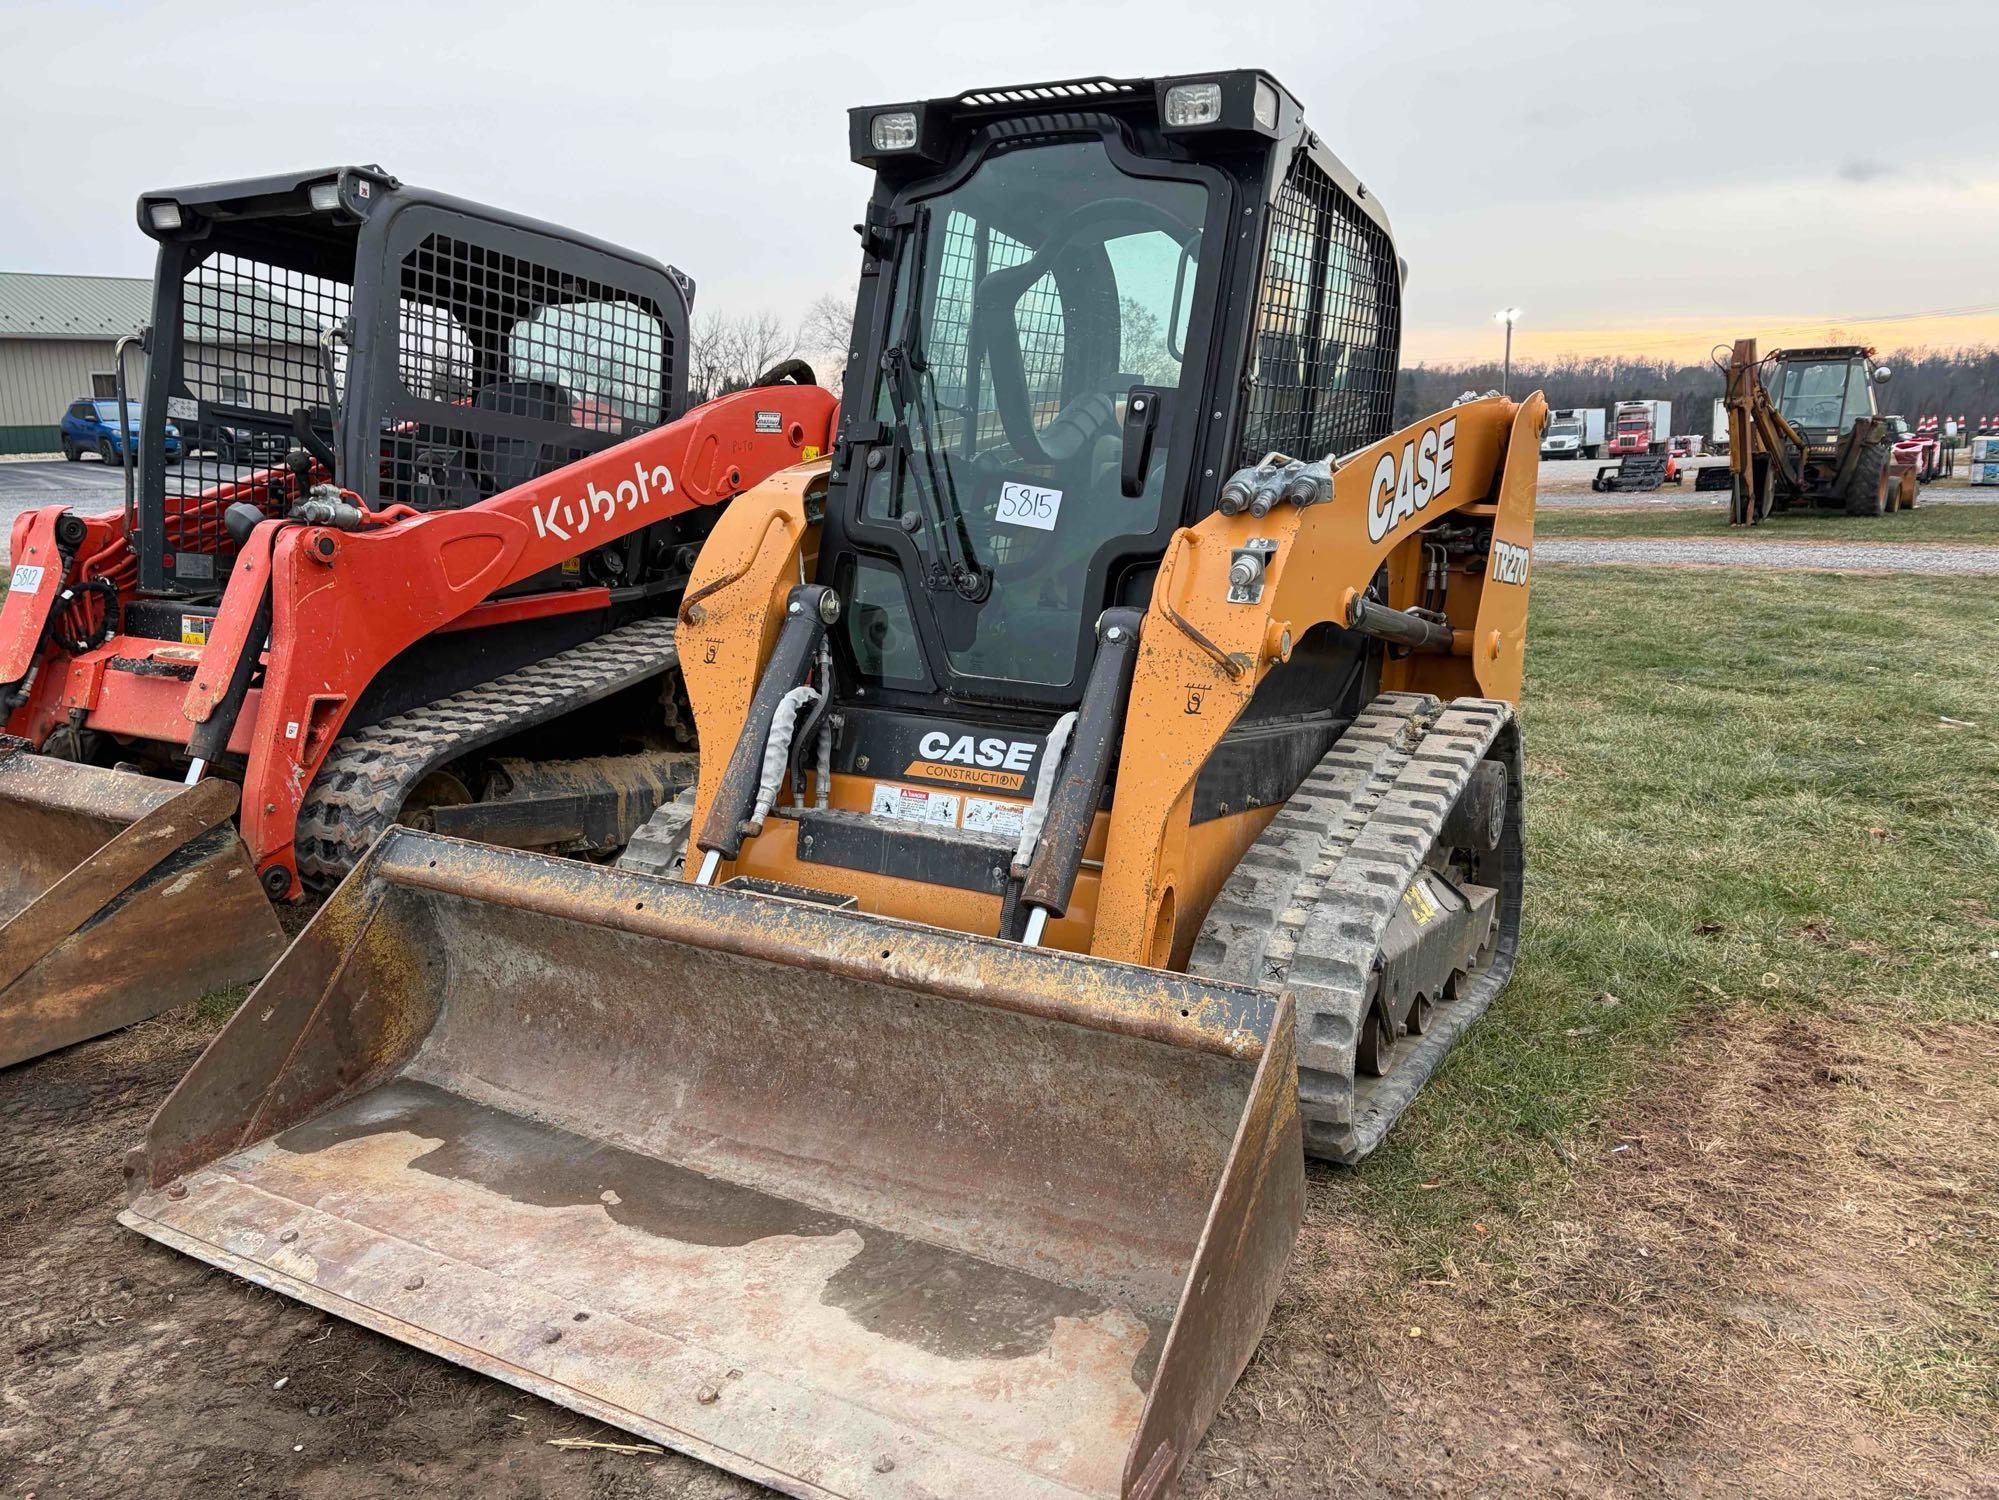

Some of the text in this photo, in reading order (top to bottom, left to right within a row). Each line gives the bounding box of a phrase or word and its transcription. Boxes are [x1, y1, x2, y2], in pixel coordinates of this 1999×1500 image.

[1367, 415, 1457, 544] CASE
[532, 461, 675, 541] Kubota
[1003, 485, 1052, 518] 5815
[12, 567, 38, 587] 5812
[1492, 539, 1530, 587] TR270
[919, 731, 1037, 771] CASE
[926, 765, 1019, 787] CONSTRUCTION
